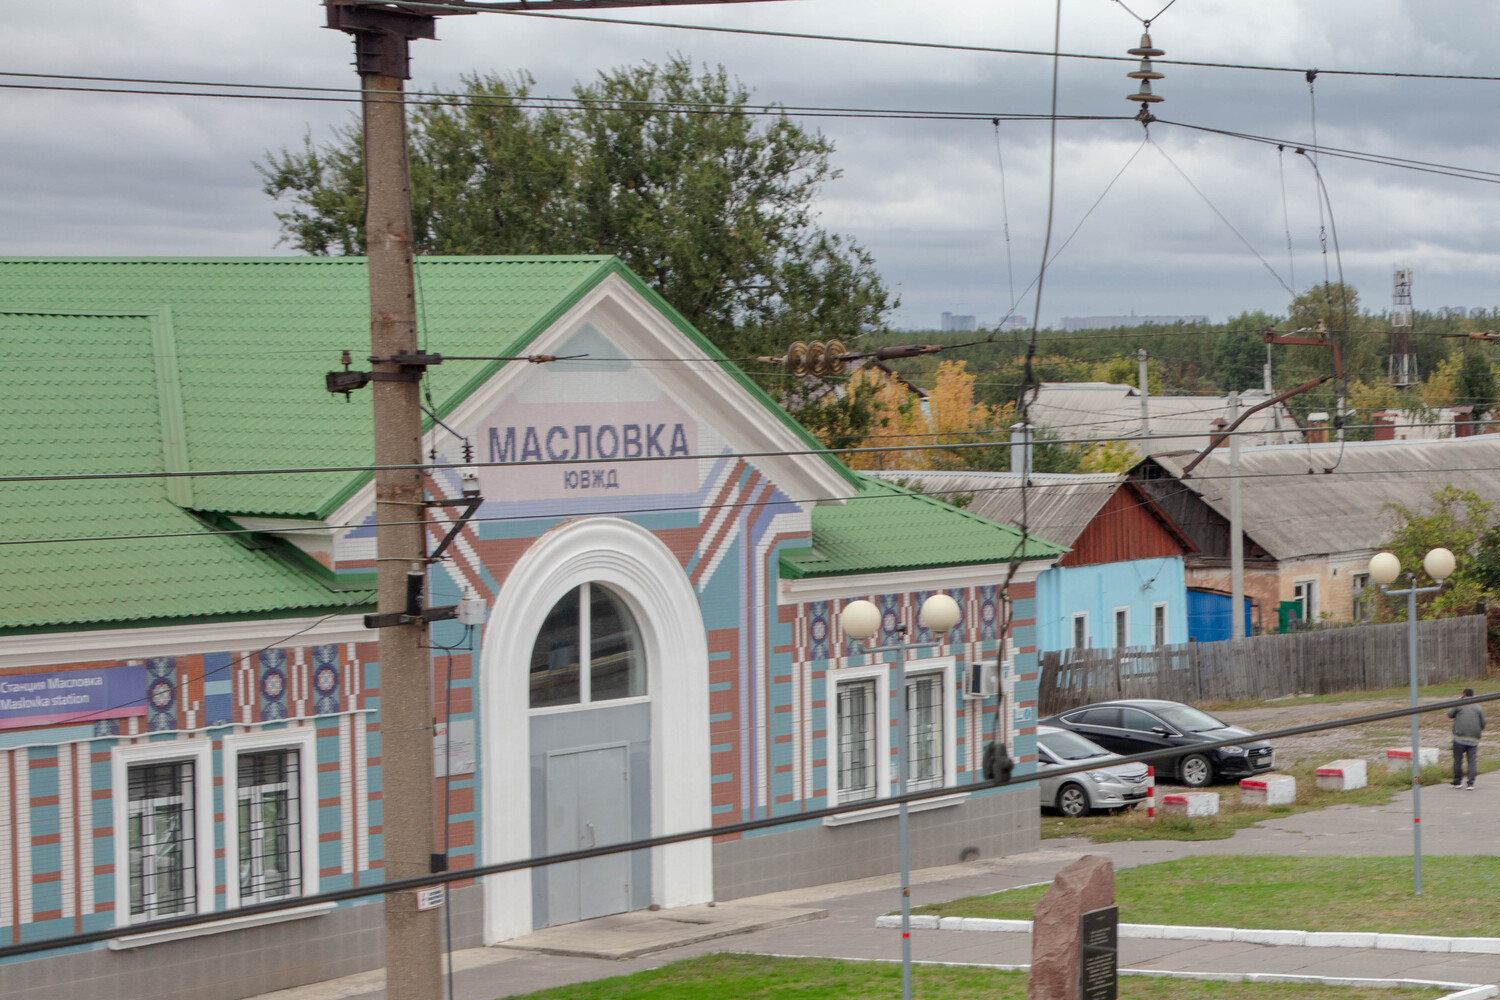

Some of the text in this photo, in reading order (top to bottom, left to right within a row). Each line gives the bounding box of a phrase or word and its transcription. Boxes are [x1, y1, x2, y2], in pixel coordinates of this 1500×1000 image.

[489, 423, 690, 462] МАСЛОВКА
[563, 469, 620, 489] ЮВЖД
[0, 677, 103, 693] Станция Масловка
[0, 693, 90, 710] Maslovka station
